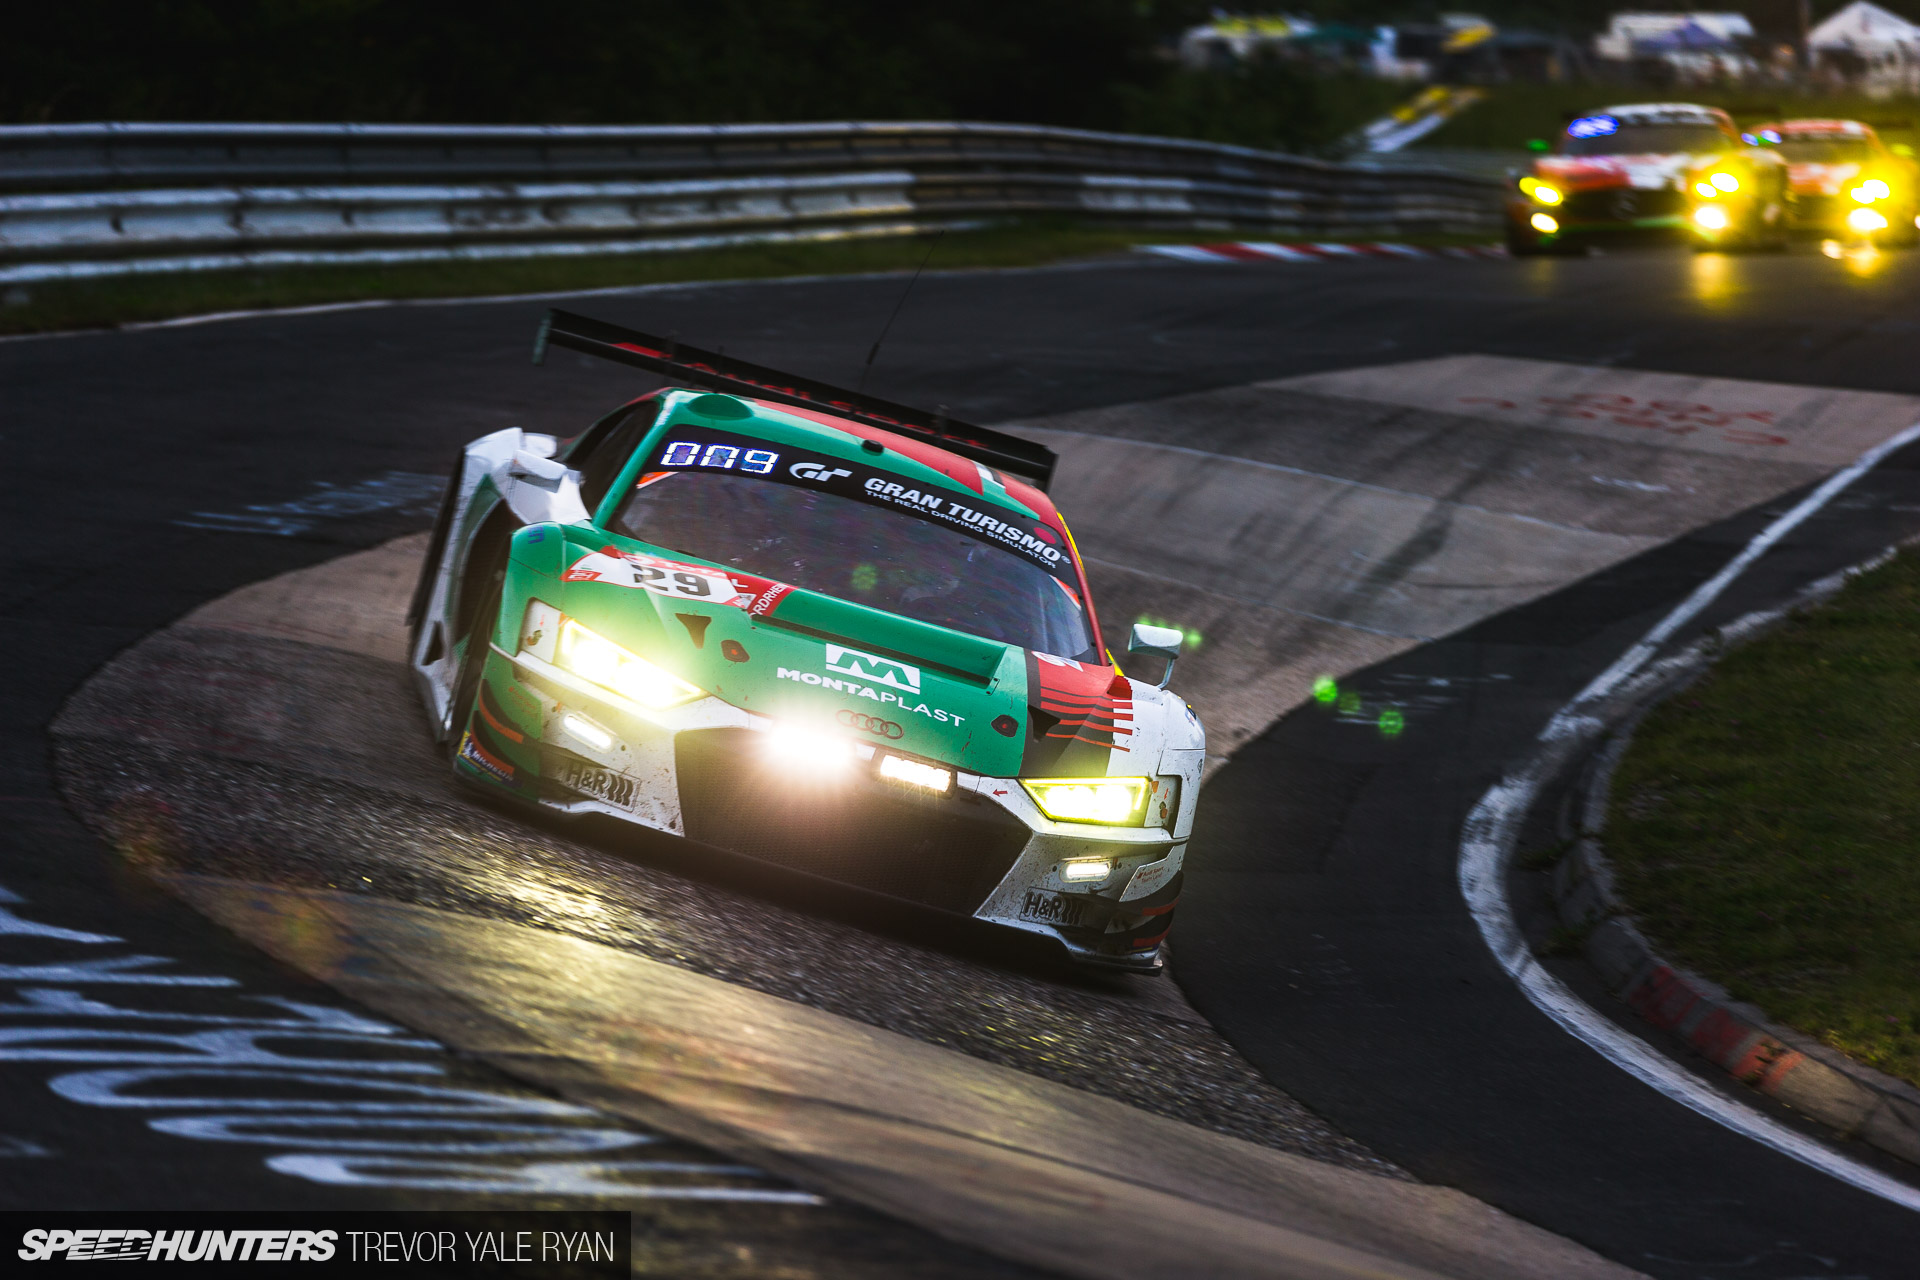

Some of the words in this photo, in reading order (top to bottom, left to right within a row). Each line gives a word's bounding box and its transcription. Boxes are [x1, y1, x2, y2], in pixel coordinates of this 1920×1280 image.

[863, 477, 943, 509] GRAN
[865, 489, 892, 502] THE
[894, 498, 929, 514] REAL
[930, 510, 984, 534] DRIVING
[986, 530, 1057, 569] SIMULATOR
[630, 563, 712, 597] 29
[776, 667, 966, 727] MONTAPLAST
[565, 766, 607, 797] H&R
[1023, 891, 1063, 918] H&R
